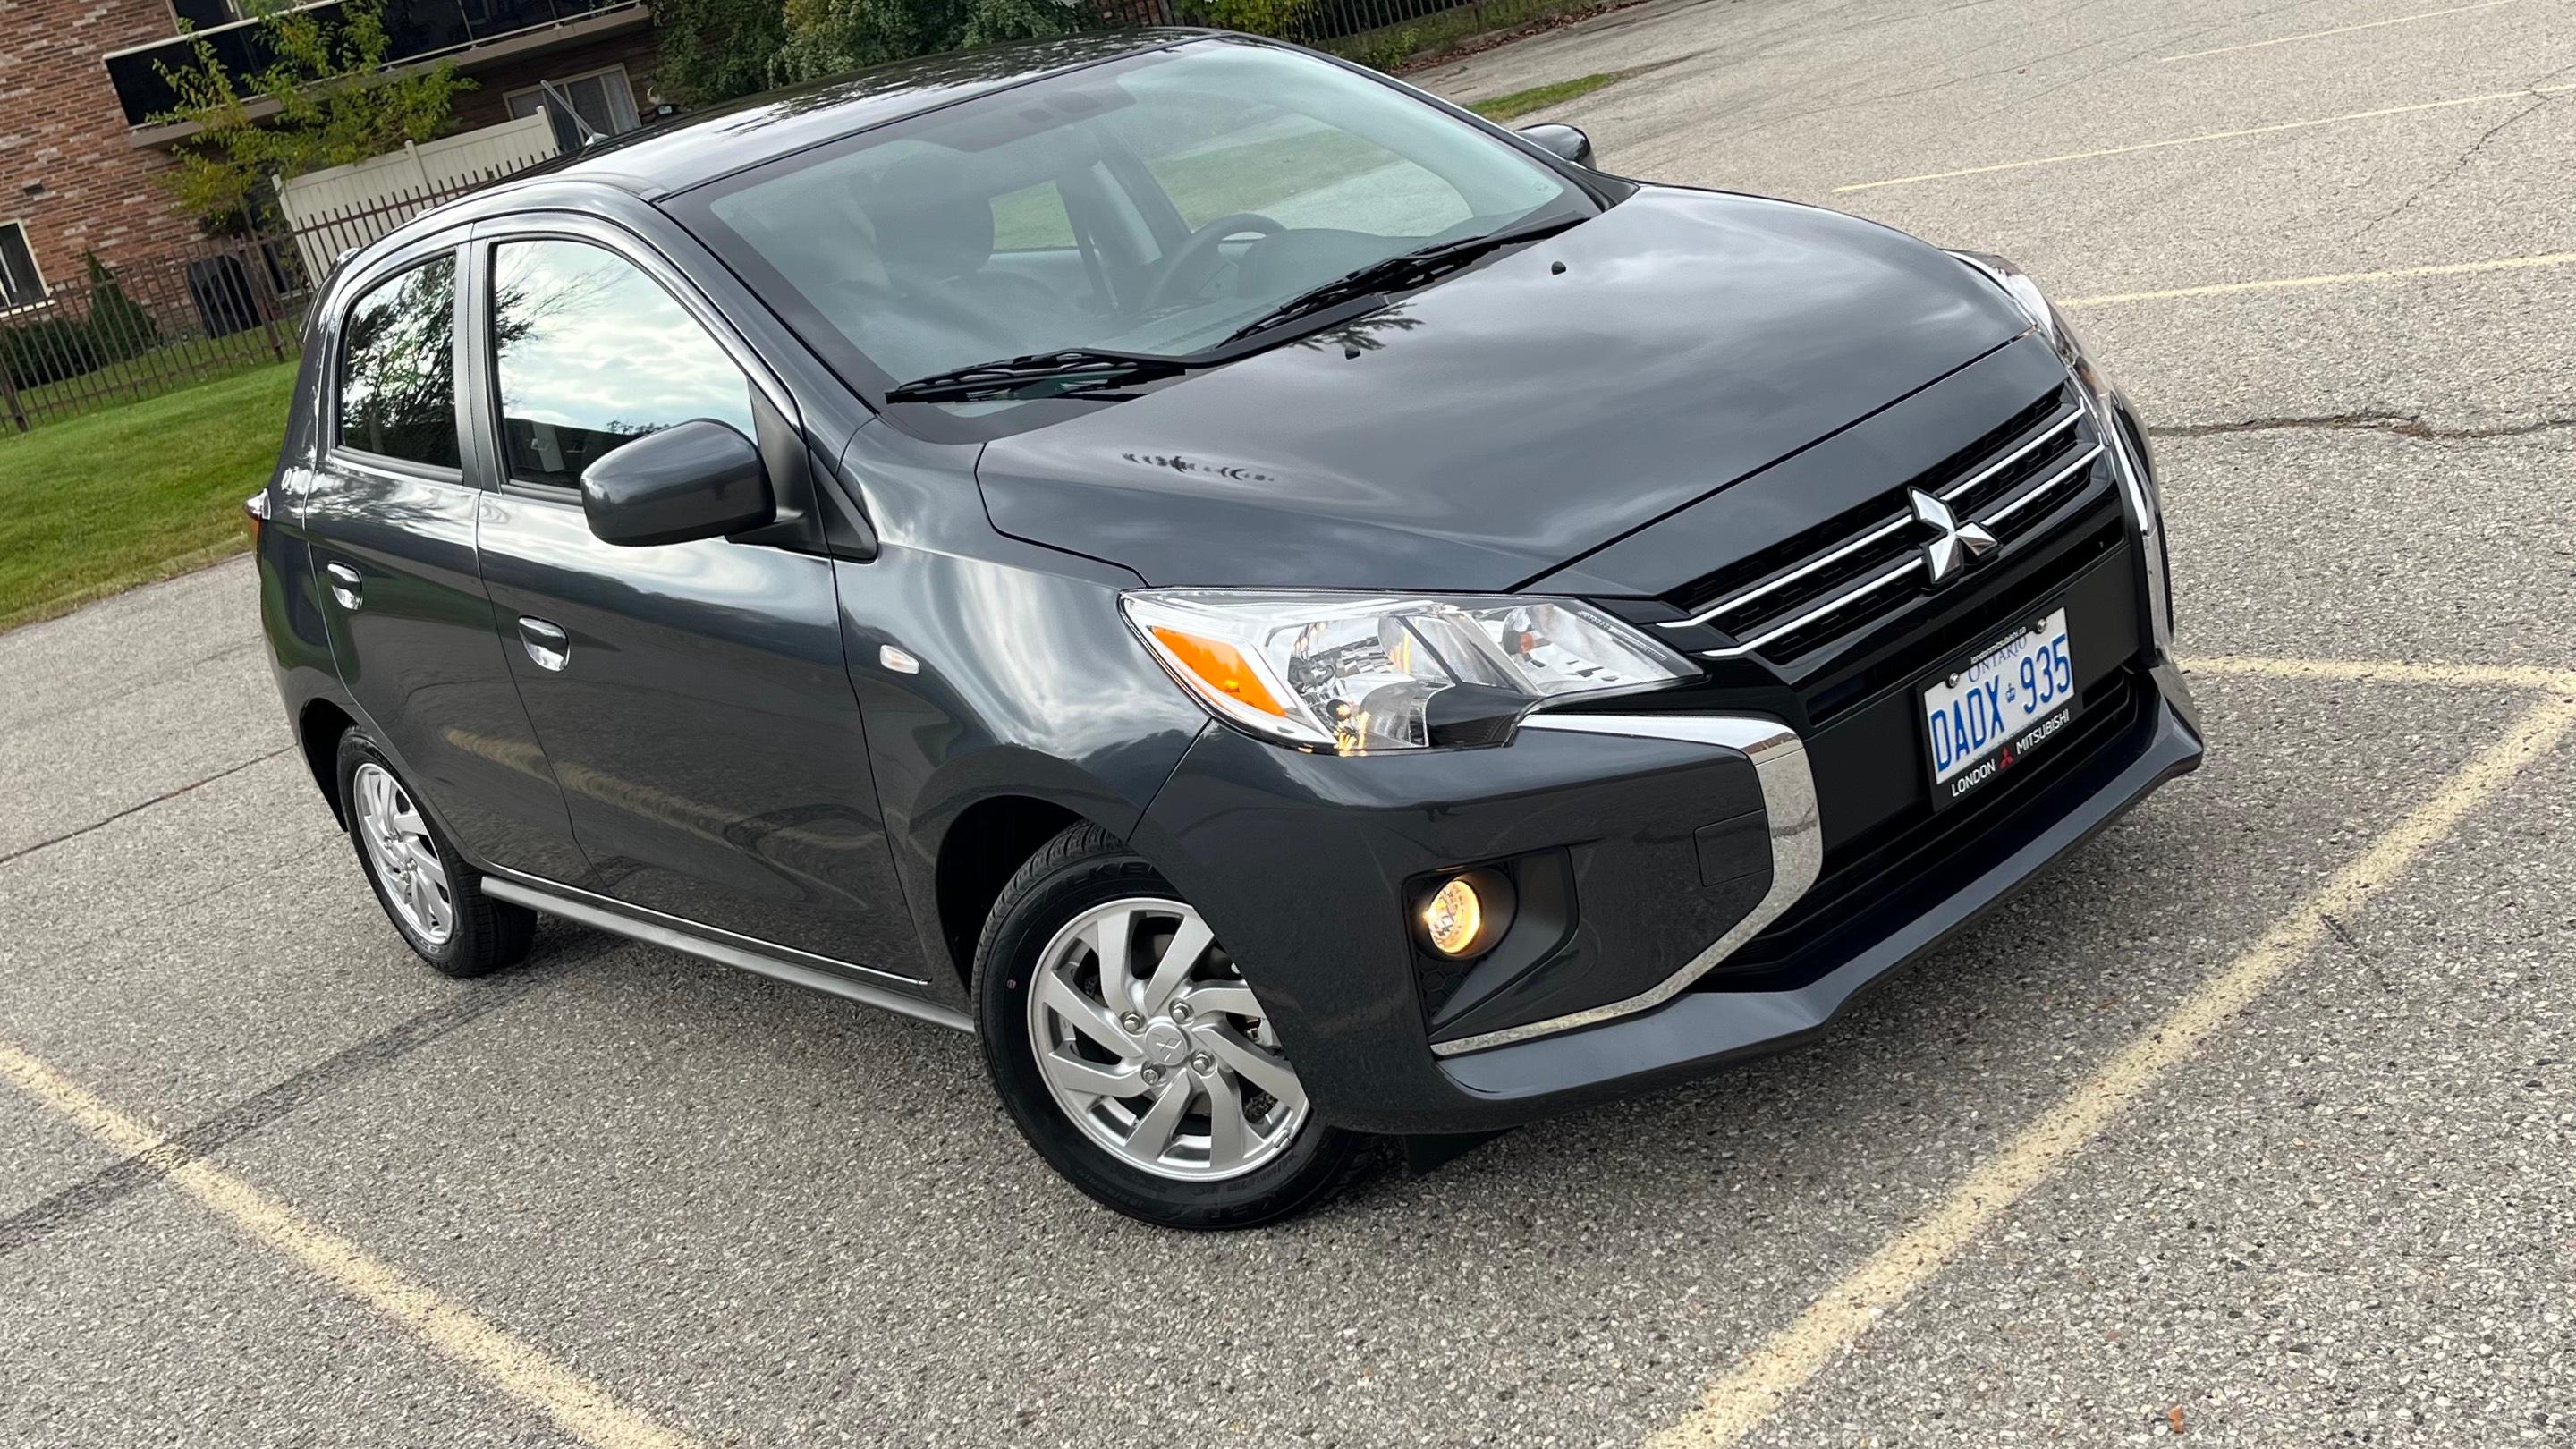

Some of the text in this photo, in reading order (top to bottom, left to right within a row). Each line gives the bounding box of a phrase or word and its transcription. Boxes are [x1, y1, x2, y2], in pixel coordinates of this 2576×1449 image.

[1930, 674, 2005, 773] DADX
[2020, 633, 2071, 714] 935
[1951, 758, 1996, 797] LONDON
[2015, 708, 2070, 755] MITSUBISHI
